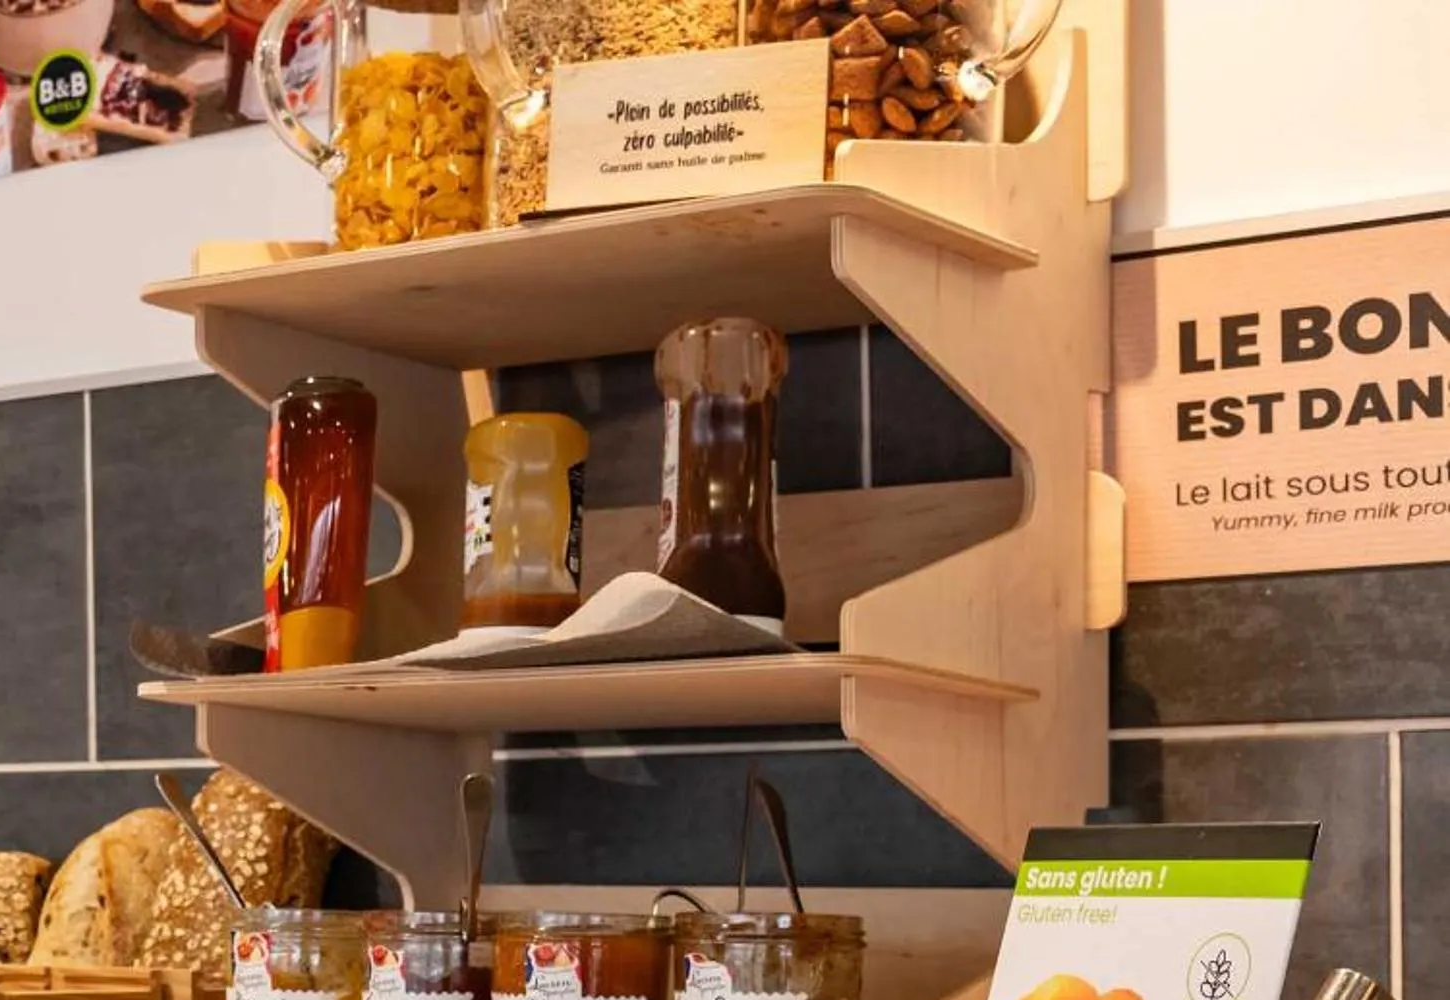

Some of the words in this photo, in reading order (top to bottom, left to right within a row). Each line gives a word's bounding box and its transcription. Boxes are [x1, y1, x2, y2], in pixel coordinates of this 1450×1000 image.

[39, 71, 87, 105] B&B
[658, 98, 675, 118] de
[678, 156, 708, 167] huile
[711, 155, 725, 164] de
[1179, 313, 1260, 375] LE
[1281, 292, 1450, 364] BON
[1177, 392, 1285, 442] EST
[1298, 375, 1450, 432] DAN
[1176, 482, 1210, 506] Le
[1223, 474, 1275, 502] lait
[1287, 471, 1370, 498] sous
[1212, 513, 1298, 532] Yummy,
[1306, 508, 1347, 525] fine
[1354, 502, 1400, 521] milk
[1407, 502, 1450, 522] pro
[1026, 866, 1076, 890] Sans
[1079, 865, 1153, 897] gluten
[1158, 866, 1168, 889] !
[1018, 904, 1072, 923] Gluten
[1076, 903, 1118, 924] free!
